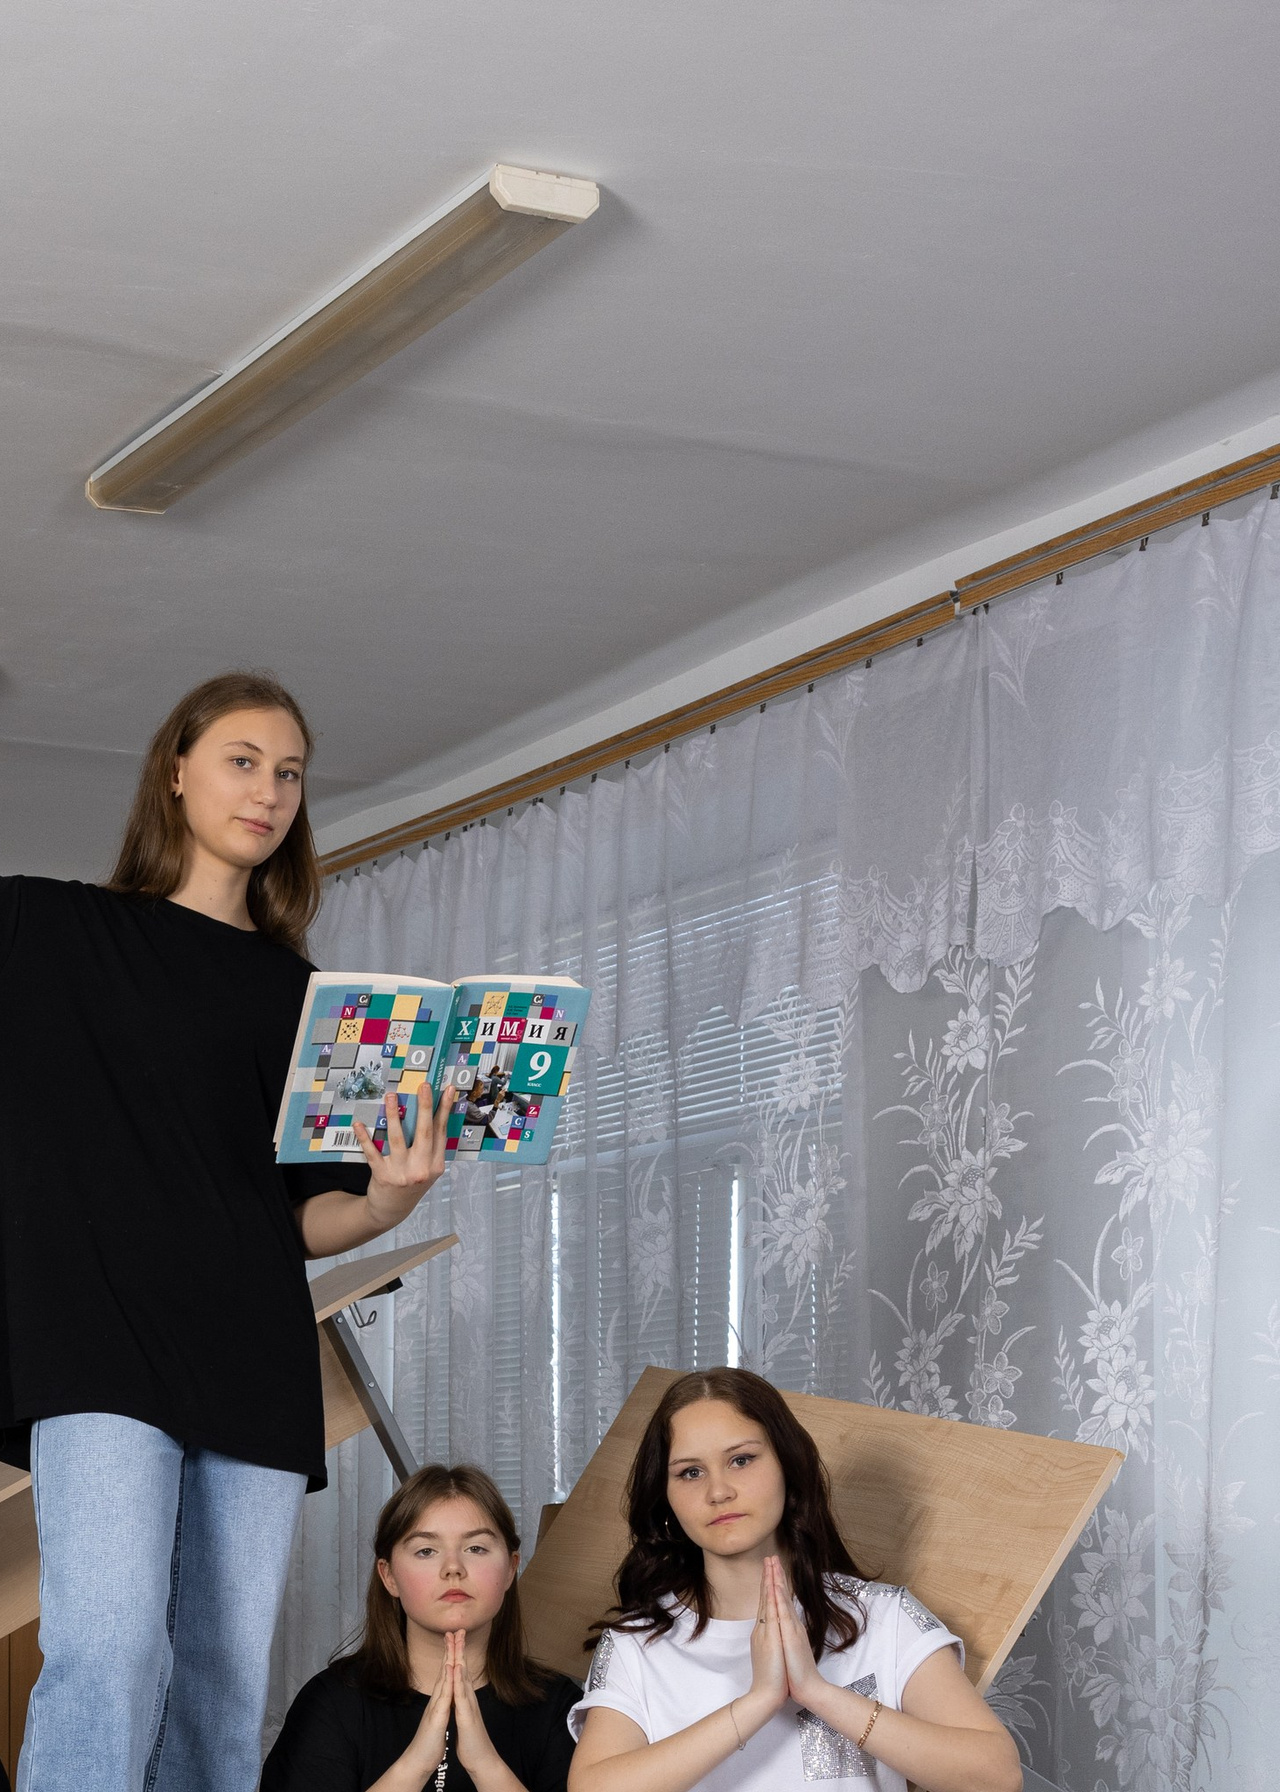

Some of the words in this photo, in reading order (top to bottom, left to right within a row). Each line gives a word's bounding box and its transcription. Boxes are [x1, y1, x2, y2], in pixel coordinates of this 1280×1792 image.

[344, 1006, 353, 1016] N
[555, 1009, 565, 1018] N
[385, 1045, 394, 1053] N
[411, 1050, 426, 1065] O
[528, 1051, 552, 1081] 9
[456, 1069, 471, 1085] O
[318, 1116, 326, 1125] F
[514, 1118, 522, 1126] C
[524, 1130, 532, 1139] S
